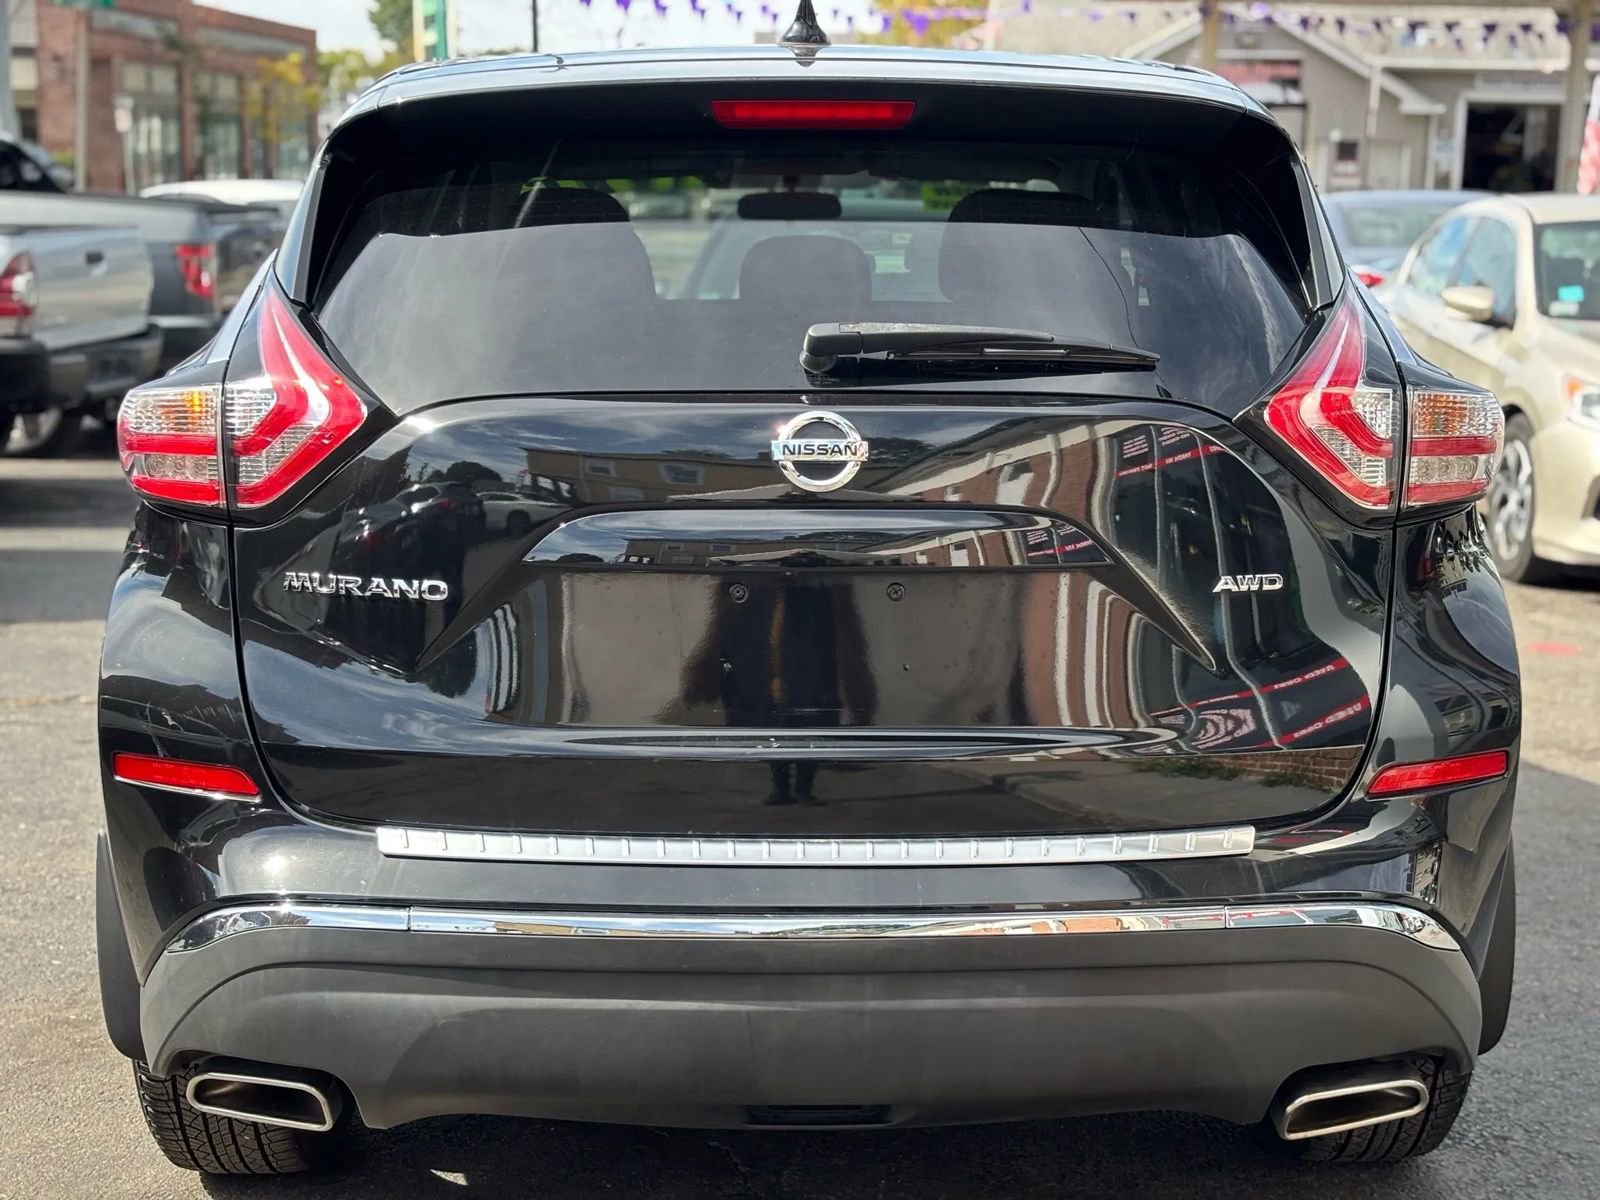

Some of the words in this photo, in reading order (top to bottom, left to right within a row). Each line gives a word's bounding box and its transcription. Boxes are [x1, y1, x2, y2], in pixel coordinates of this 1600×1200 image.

[782, 444, 858, 456] NISSAN
[282, 571, 449, 601] MURANO
[1212, 574, 1284, 593] AWD
